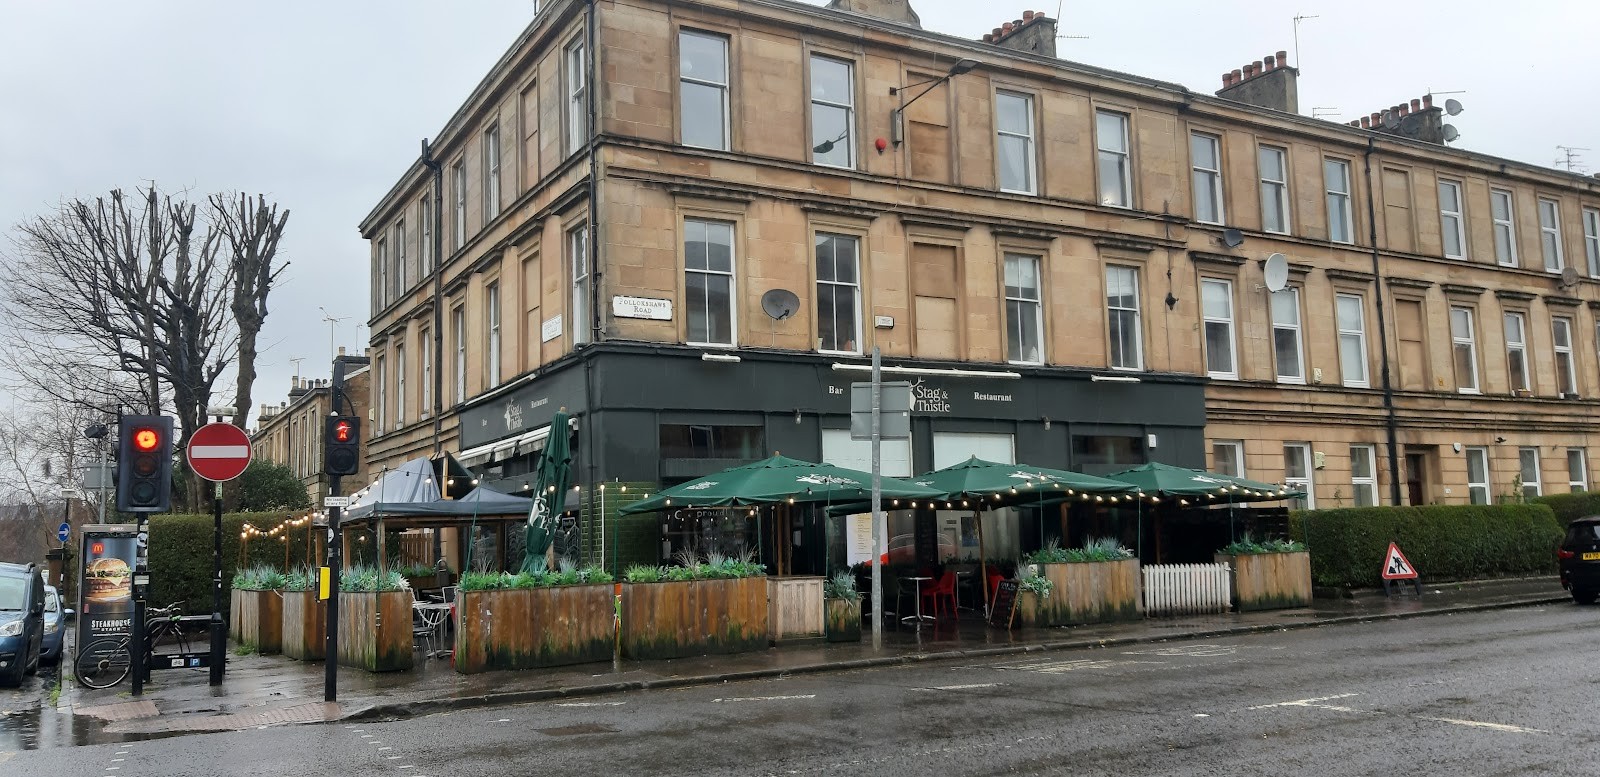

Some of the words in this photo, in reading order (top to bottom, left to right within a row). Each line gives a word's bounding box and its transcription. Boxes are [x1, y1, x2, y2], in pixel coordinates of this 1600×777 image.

[618, 298, 667, 308] POLLOKSHAWS
[633, 306, 653, 314] ROAD
[828, 385, 844, 395] Bar
[916, 385, 941, 402] Stag
[941, 390, 949, 400] &
[974, 391, 1012, 402] Restaurant
[916, 399, 951, 412] Thistle
[91, 618, 131, 628] STEAKHOUSE
